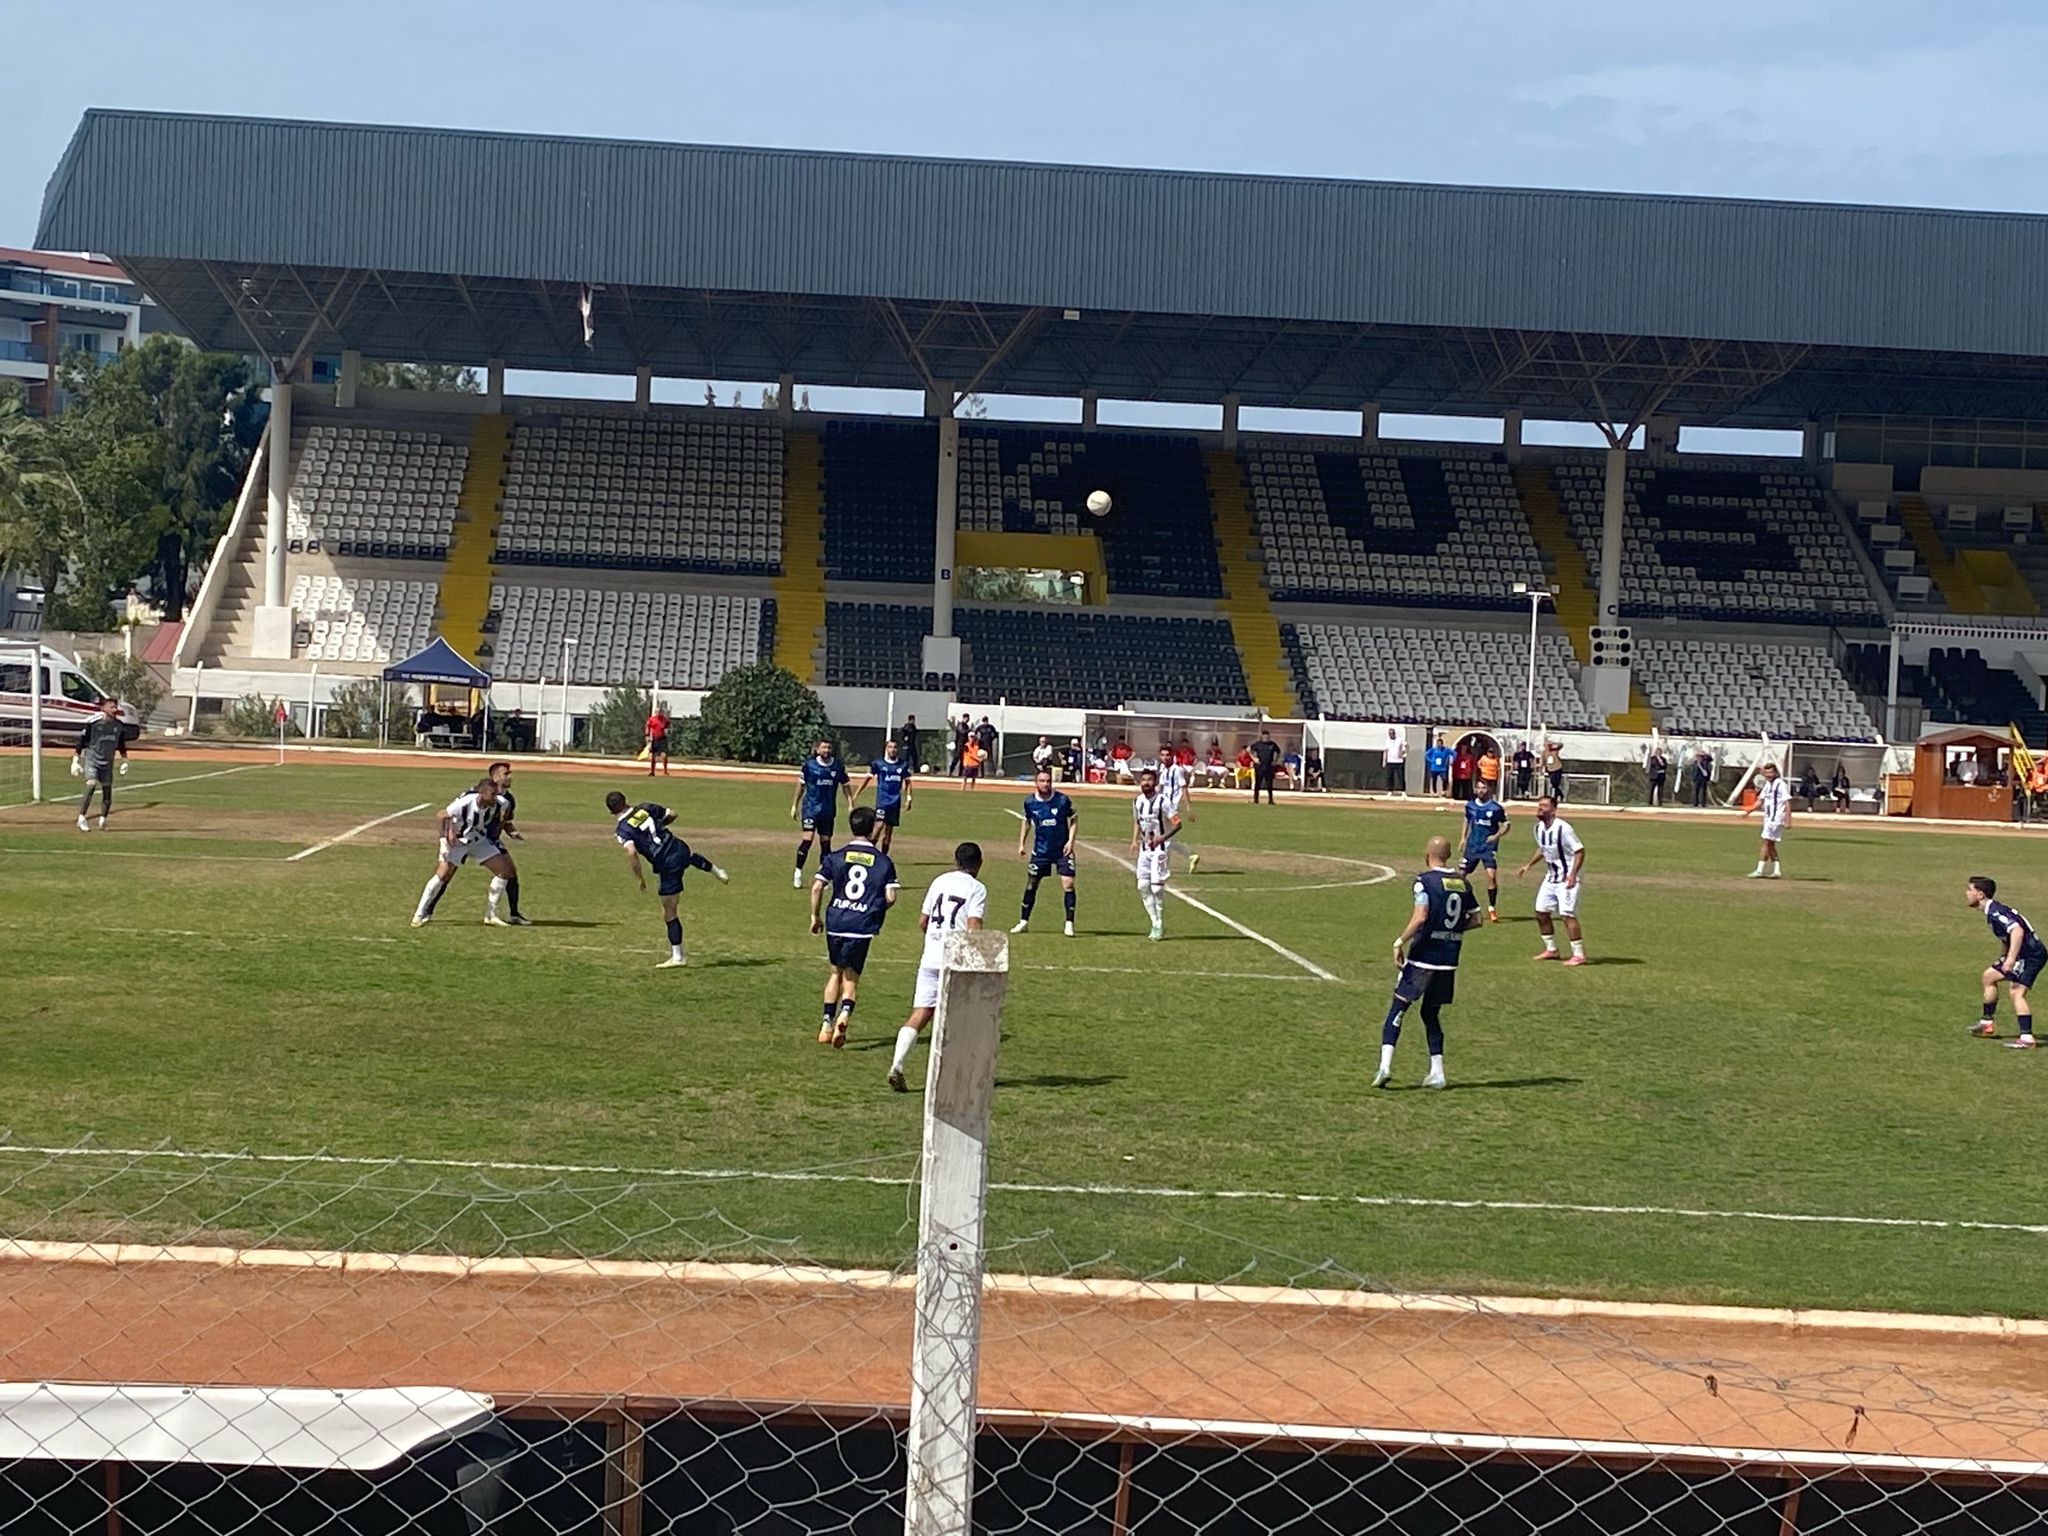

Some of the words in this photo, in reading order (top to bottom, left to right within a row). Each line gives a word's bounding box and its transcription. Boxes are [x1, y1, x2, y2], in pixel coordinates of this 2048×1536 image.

[941, 568, 951, 580] B
[845, 865, 868, 899] 8
[931, 893, 966, 929] 47
[1444, 893, 1462, 929] 9
